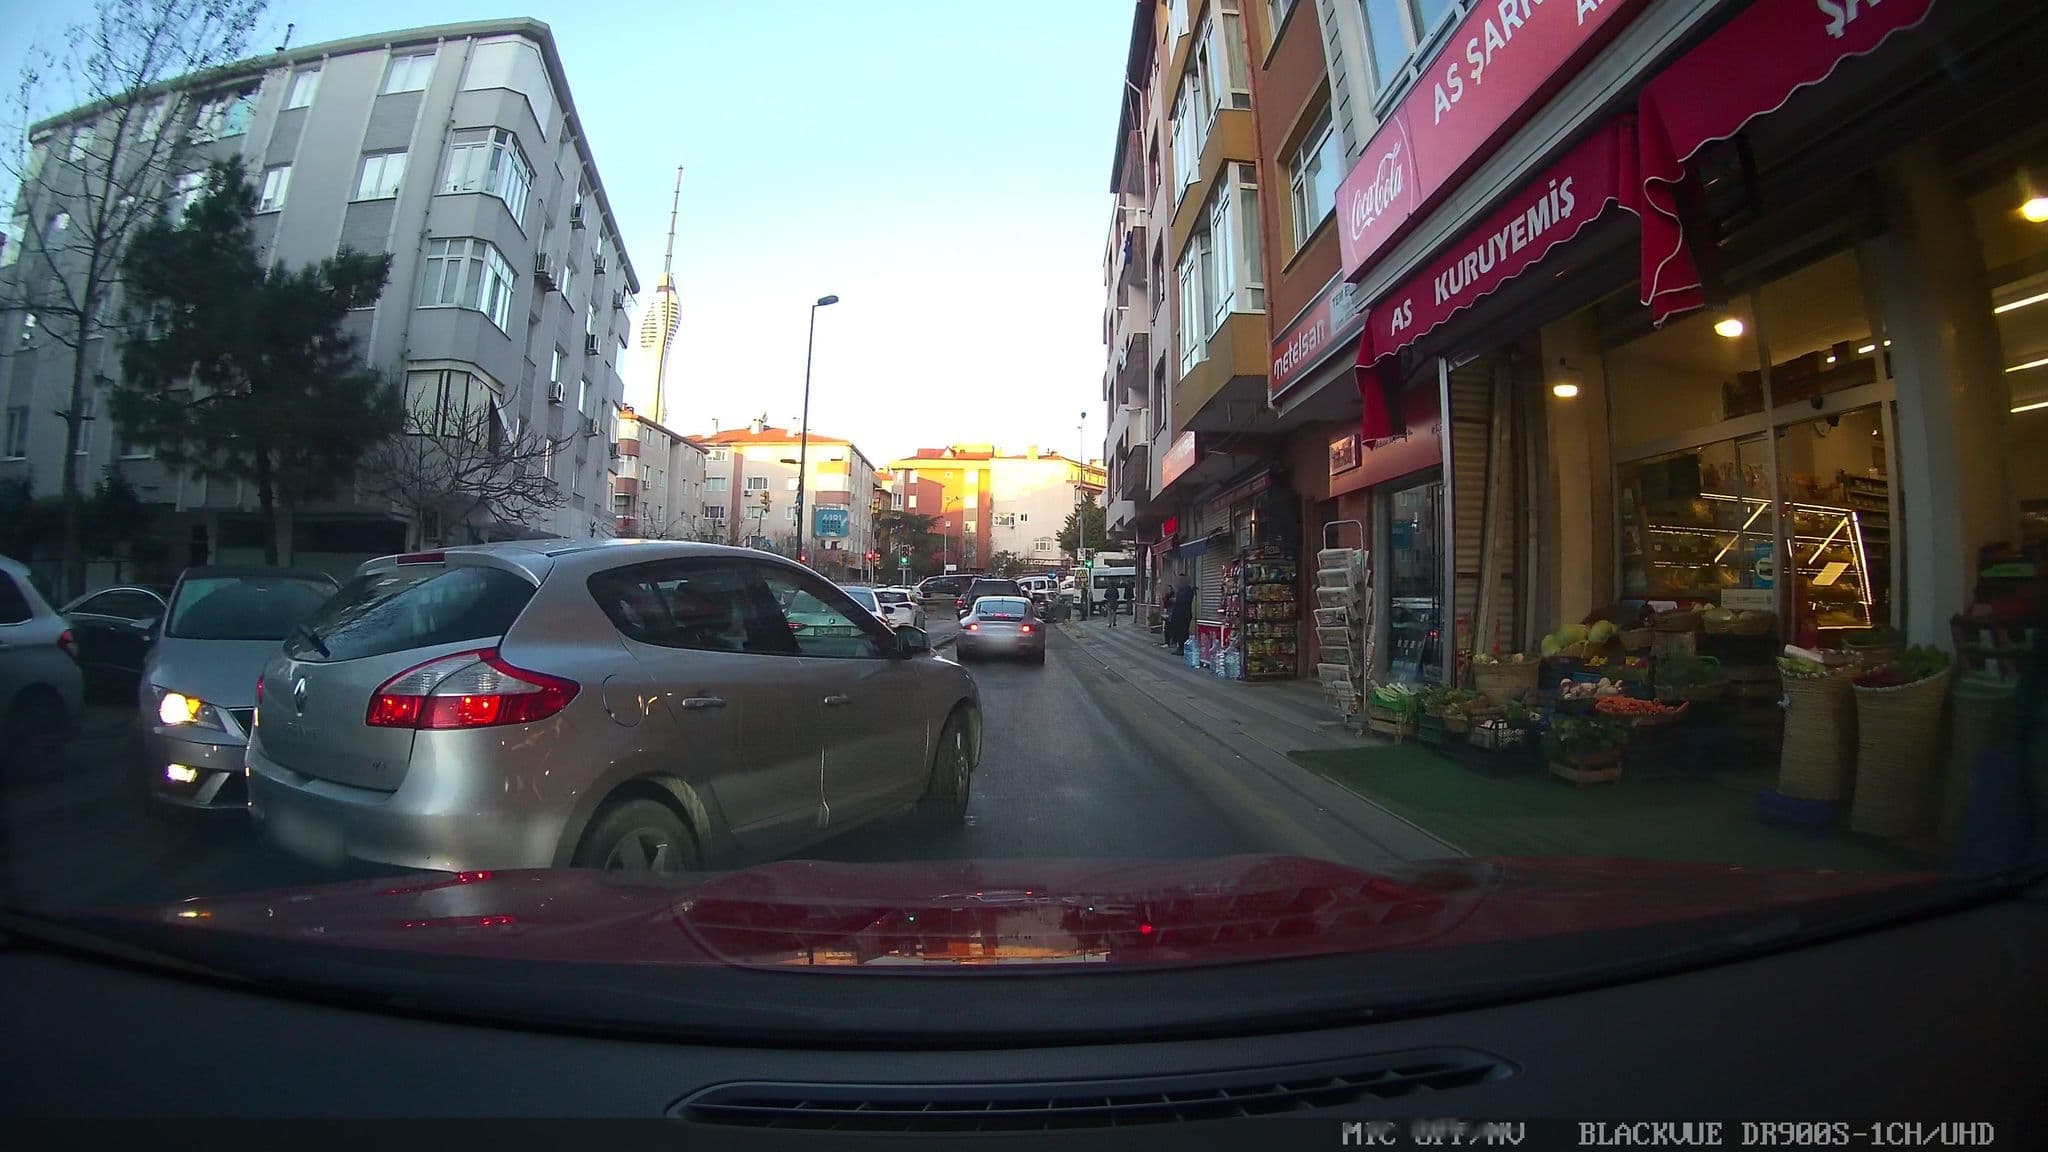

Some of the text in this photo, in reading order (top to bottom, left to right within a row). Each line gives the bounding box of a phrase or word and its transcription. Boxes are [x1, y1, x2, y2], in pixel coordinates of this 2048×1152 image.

[1434, 62, 1464, 126] AS
[1390, 175, 1576, 337] AS KURUYEMİŞ
[1273, 319, 1326, 380] metelsan
